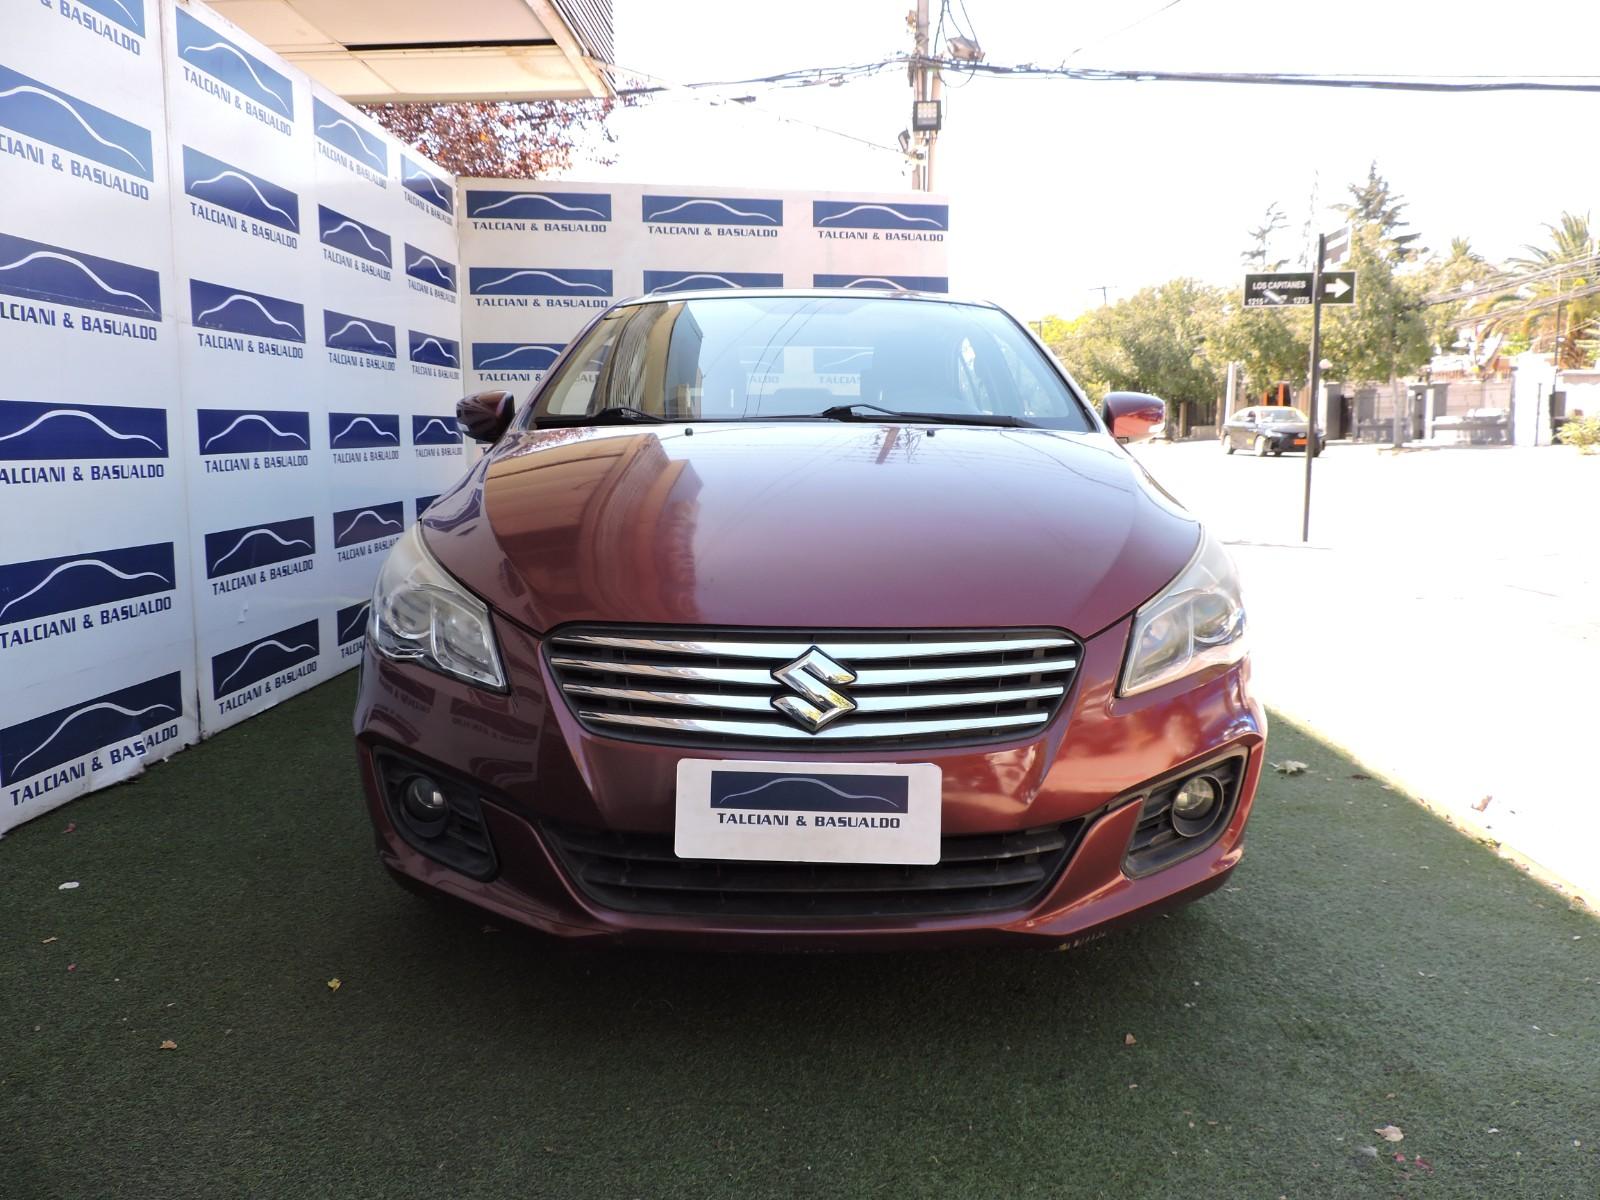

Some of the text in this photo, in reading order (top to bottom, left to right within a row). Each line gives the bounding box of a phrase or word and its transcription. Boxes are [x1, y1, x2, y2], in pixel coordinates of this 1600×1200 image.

[60, 1, 140, 55] BASUALDO
[184, 66, 291, 136] TALCIANI & BASUALDO
[317, 142, 347, 169] TALCIANI
[0, 133, 149, 200] CIANI & BASUALDO
[190, 202, 297, 249] TALCIANI & BASUALDO
[473, 221, 607, 233] TALCIANI & BASUALDO
[648, 225, 778, 238] TALCIANI & BASUALDO
[818, 230, 944, 242] TALCIANI & BASUALDO
[323, 248, 391, 281] TALCIANI & BASUALDO
[1252, 281, 1267, 290] LOS
[476, 298, 609, 308] TALCIANI & BASUALDO
[0, 301, 157, 341] LCIANI & BASUALDO
[198, 333, 304, 359] TALCIANI & BASUALDO
[328, 352, 396, 371] TALCIANI & BASUALDO
[478, 373, 530, 381] TALCIANI
[819, 376, 860, 384] TALCIA
[205, 455, 308, 473] TALCIANI & BASUALDO
[333, 450, 399, 464] TALCIANI & BASUALDO
[0, 464, 164, 484] ALCIANI & BASUALDO
[337, 546, 366, 562] TALCIANI
[368, 544, 373, 554] &
[212, 559, 313, 596] TALCIANI & BASUALDO
[0, 596, 172, 649] TALCIANI & BASUALDO
[218, 661, 317, 715] TALCIANI & BASUALDO
[10, 724, 178, 806] TALCIANI & BASALDO
[717, 813, 900, 829] TALCIANI & BASUALDO
